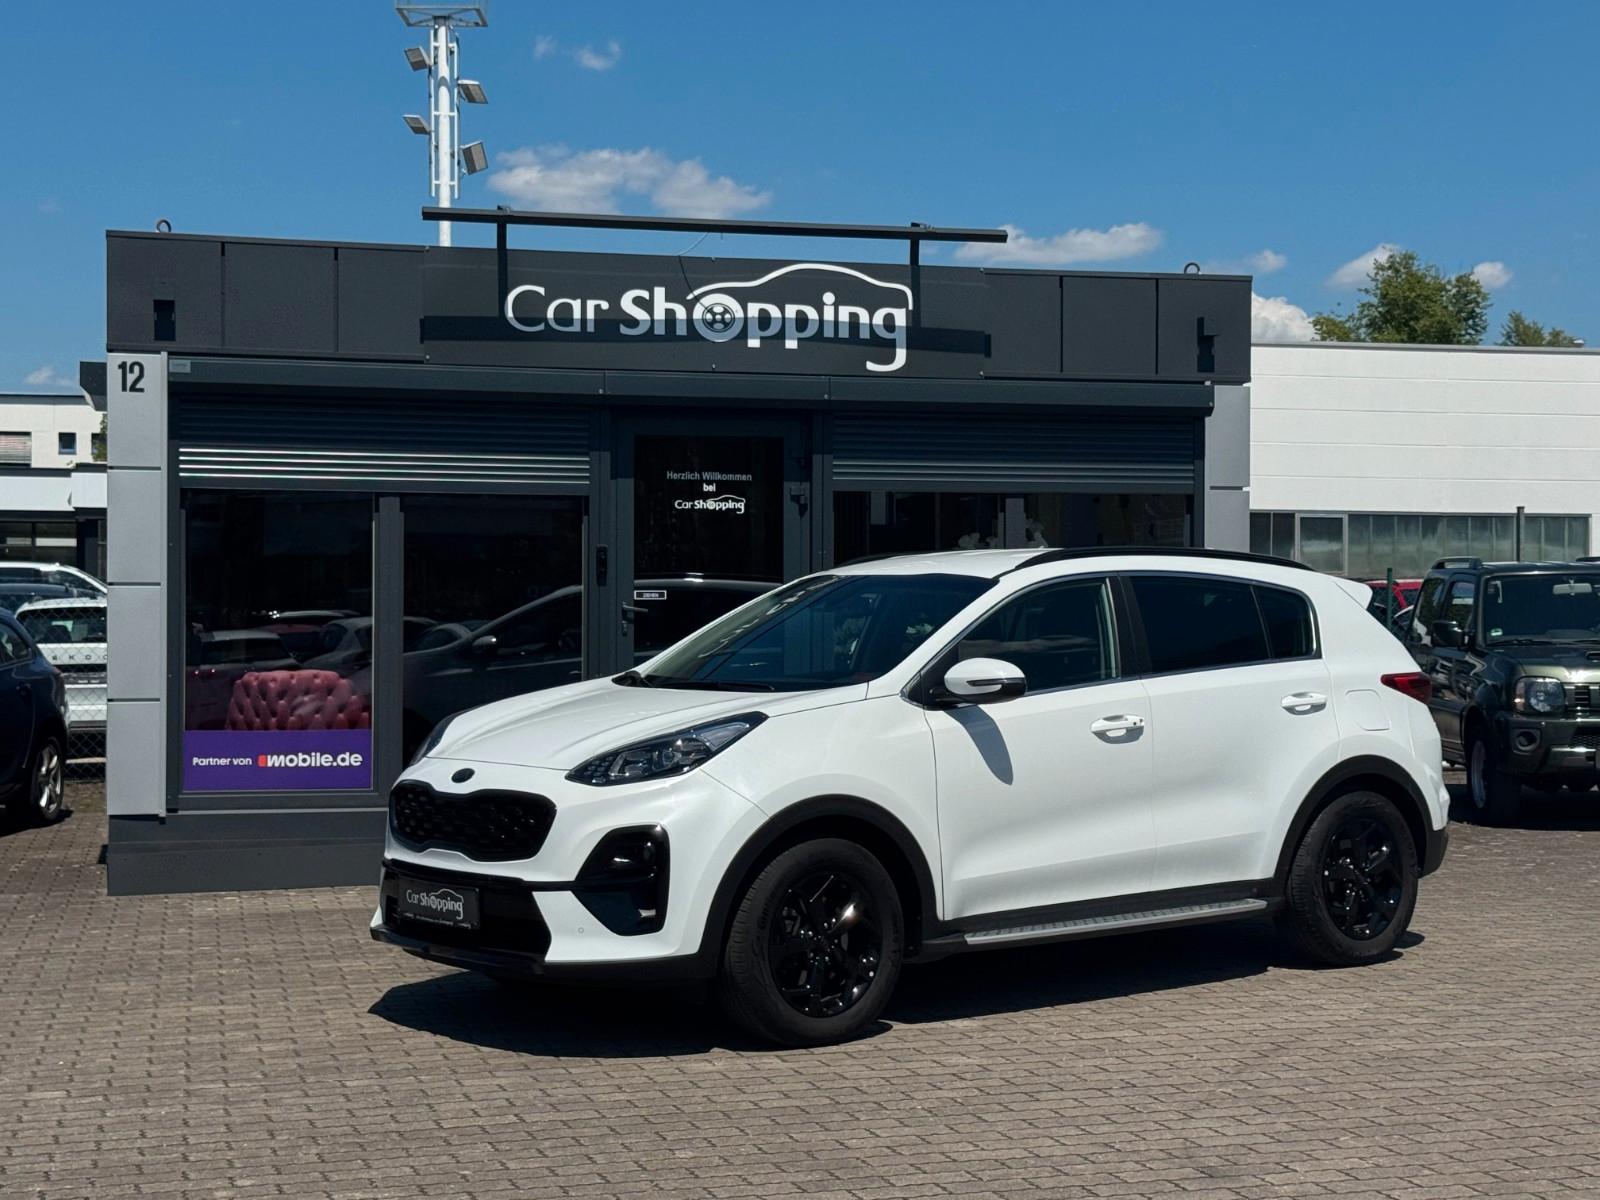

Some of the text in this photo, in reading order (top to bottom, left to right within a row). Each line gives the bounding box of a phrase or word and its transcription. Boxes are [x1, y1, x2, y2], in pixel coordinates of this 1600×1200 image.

[118, 361, 145, 393] 12
[666, 471, 752, 482] Herzlich Willkommen
[703, 483, 716, 492] bei
[192, 752, 363, 768] Partner von mobile.de
